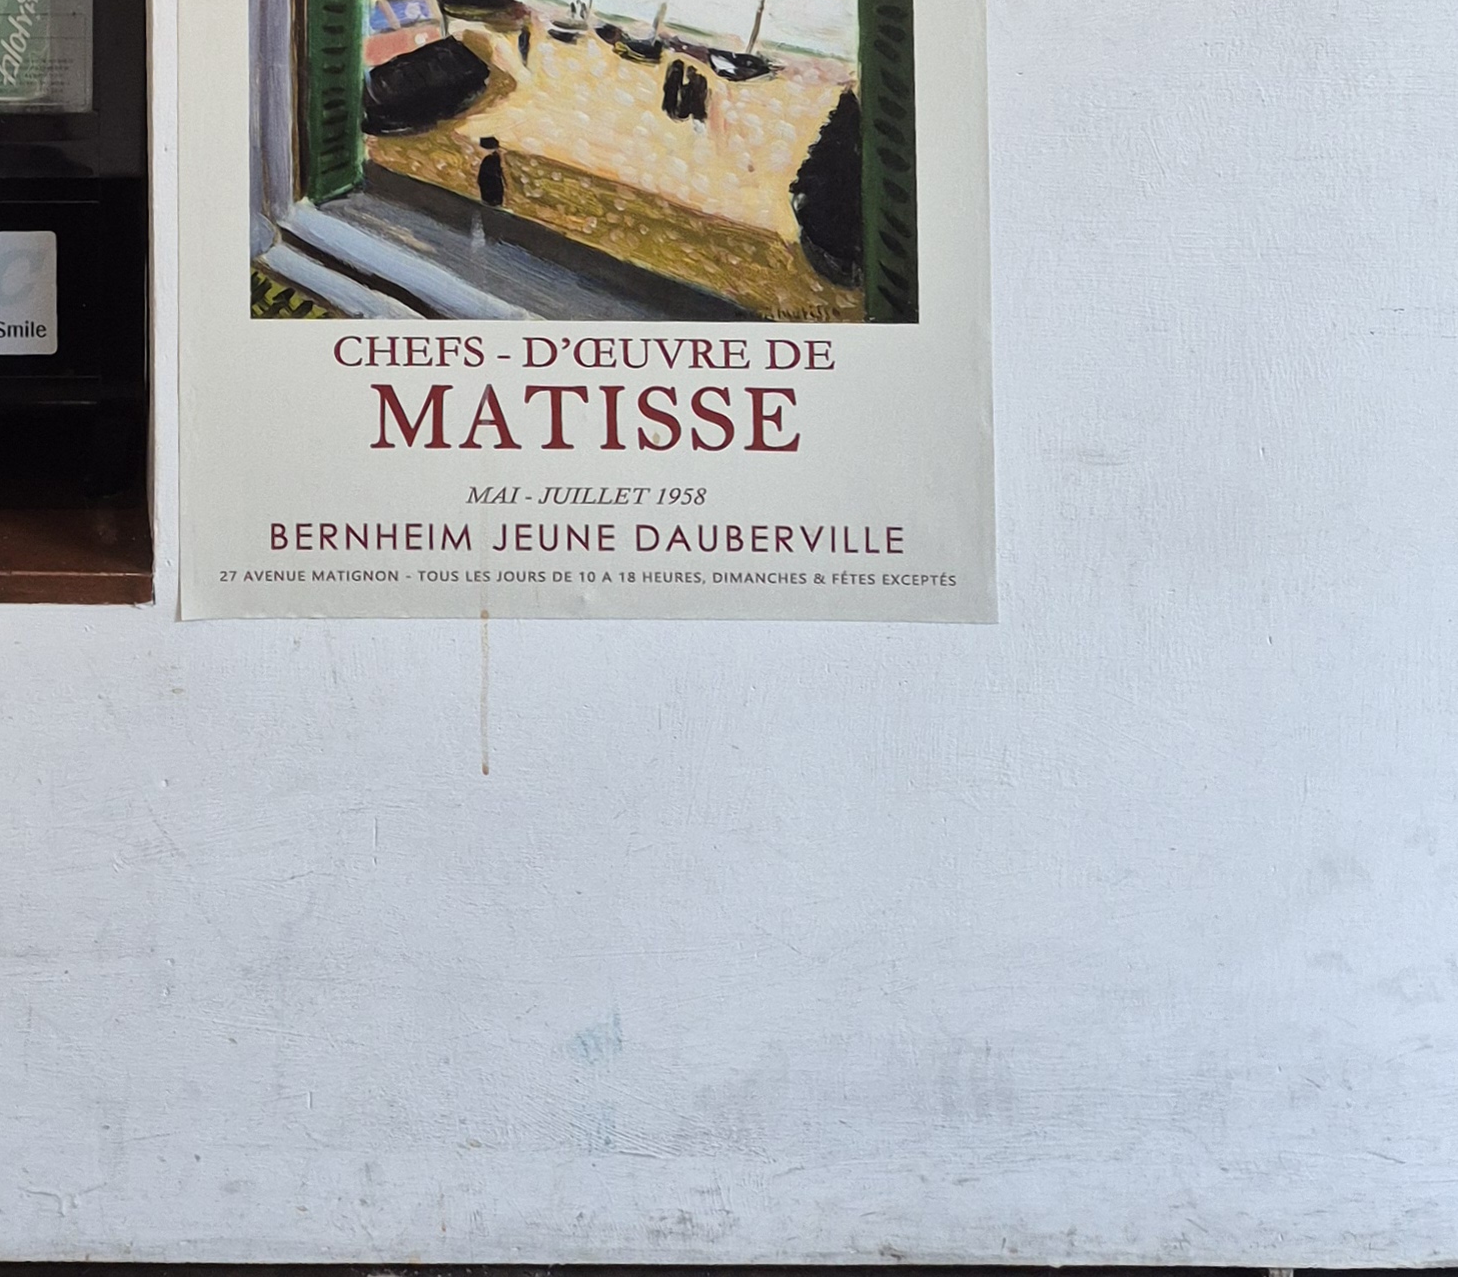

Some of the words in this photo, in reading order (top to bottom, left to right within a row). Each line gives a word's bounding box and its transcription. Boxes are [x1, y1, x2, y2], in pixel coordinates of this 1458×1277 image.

[333, 335, 485, 367] CHEFS
[765, 339, 836, 370] DE
[370, 383, 800, 452] MATISSE
[465, 486, 521, 505] MAI
[537, 486, 650, 506] JUILLET
[656, 487, 707, 506] 1958
[270, 523, 472, 551] BERNHEIM
[492, 524, 615, 552] JEUNE
[635, 525, 904, 555] DAUBERVILLE
[219, 570, 237, 583] 27
[243, 570, 306, 583] AVENUE
[311, 570, 399, 583] MATIGNON
[417, 570, 460, 583] TOUS
[466, 570, 491, 583] LES
[496, 570, 547, 584] JOURS
[552, 571, 574, 583] DE
[579, 571, 596, 584] 10
[601, 572, 613, 584] A
[618, 572, 636, 584] 18
[642, 572, 707, 585] HEURES,
[712, 572, 808, 585] DIMANCHES
[813, 573, 826, 585] &
[882, 571, 957, 587] EXCEPTÉS
